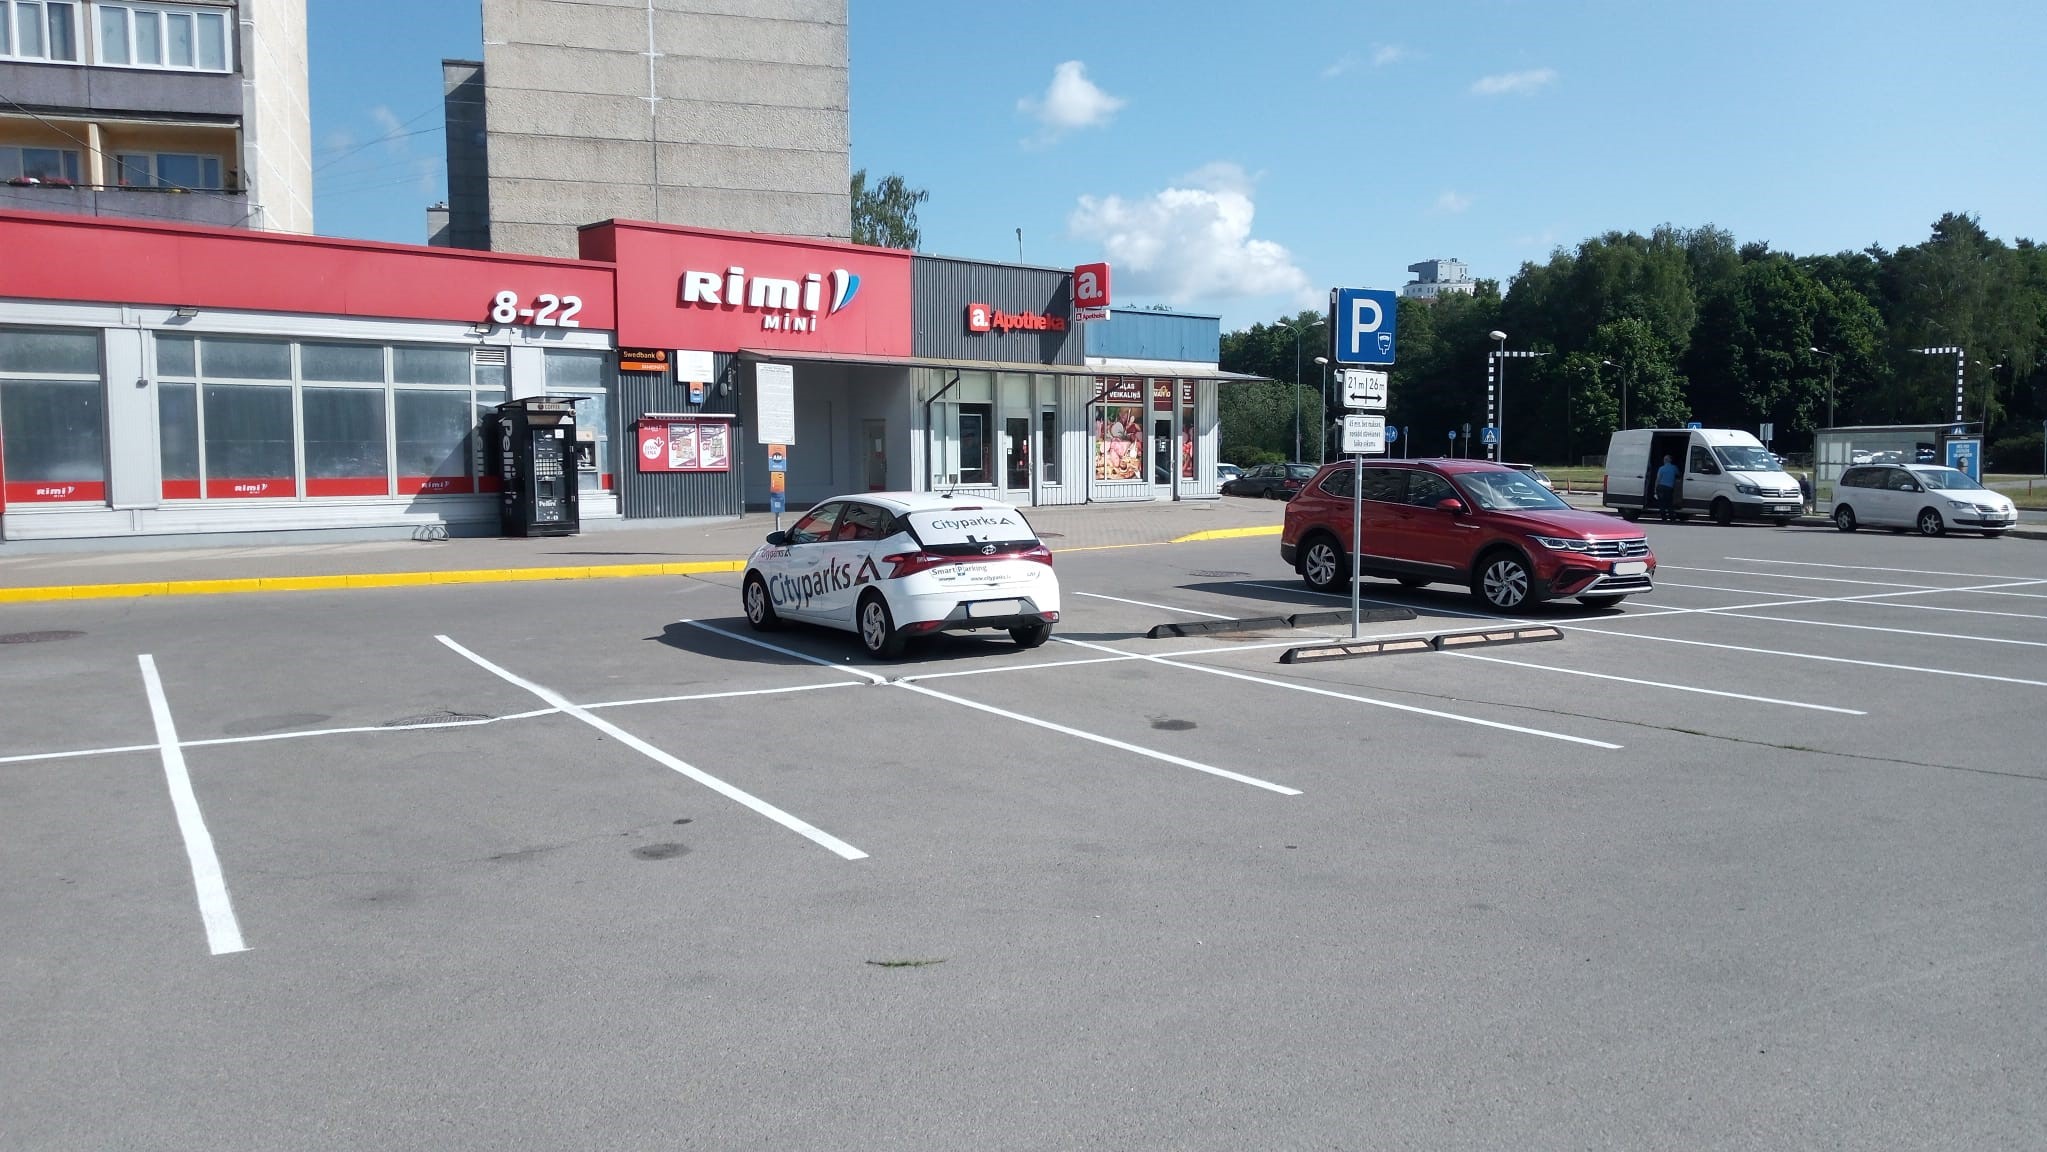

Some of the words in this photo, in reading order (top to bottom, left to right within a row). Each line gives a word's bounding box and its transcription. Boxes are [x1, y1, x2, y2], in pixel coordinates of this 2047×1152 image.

[683, 266, 822, 312] Rimi
[493, 290, 583, 327] 8-22
[992, 310, 1065, 333] Apotheka
[1351, 298, 1383, 354] P
[623, 350, 656, 359] Swedbank
[1348, 376, 1357, 389] 21
[1369, 378, 1379, 390] 26
[932, 516, 997, 530] Cityparks
[931, 567, 956, 576] Smart
[769, 557, 851, 610] Cityparks
